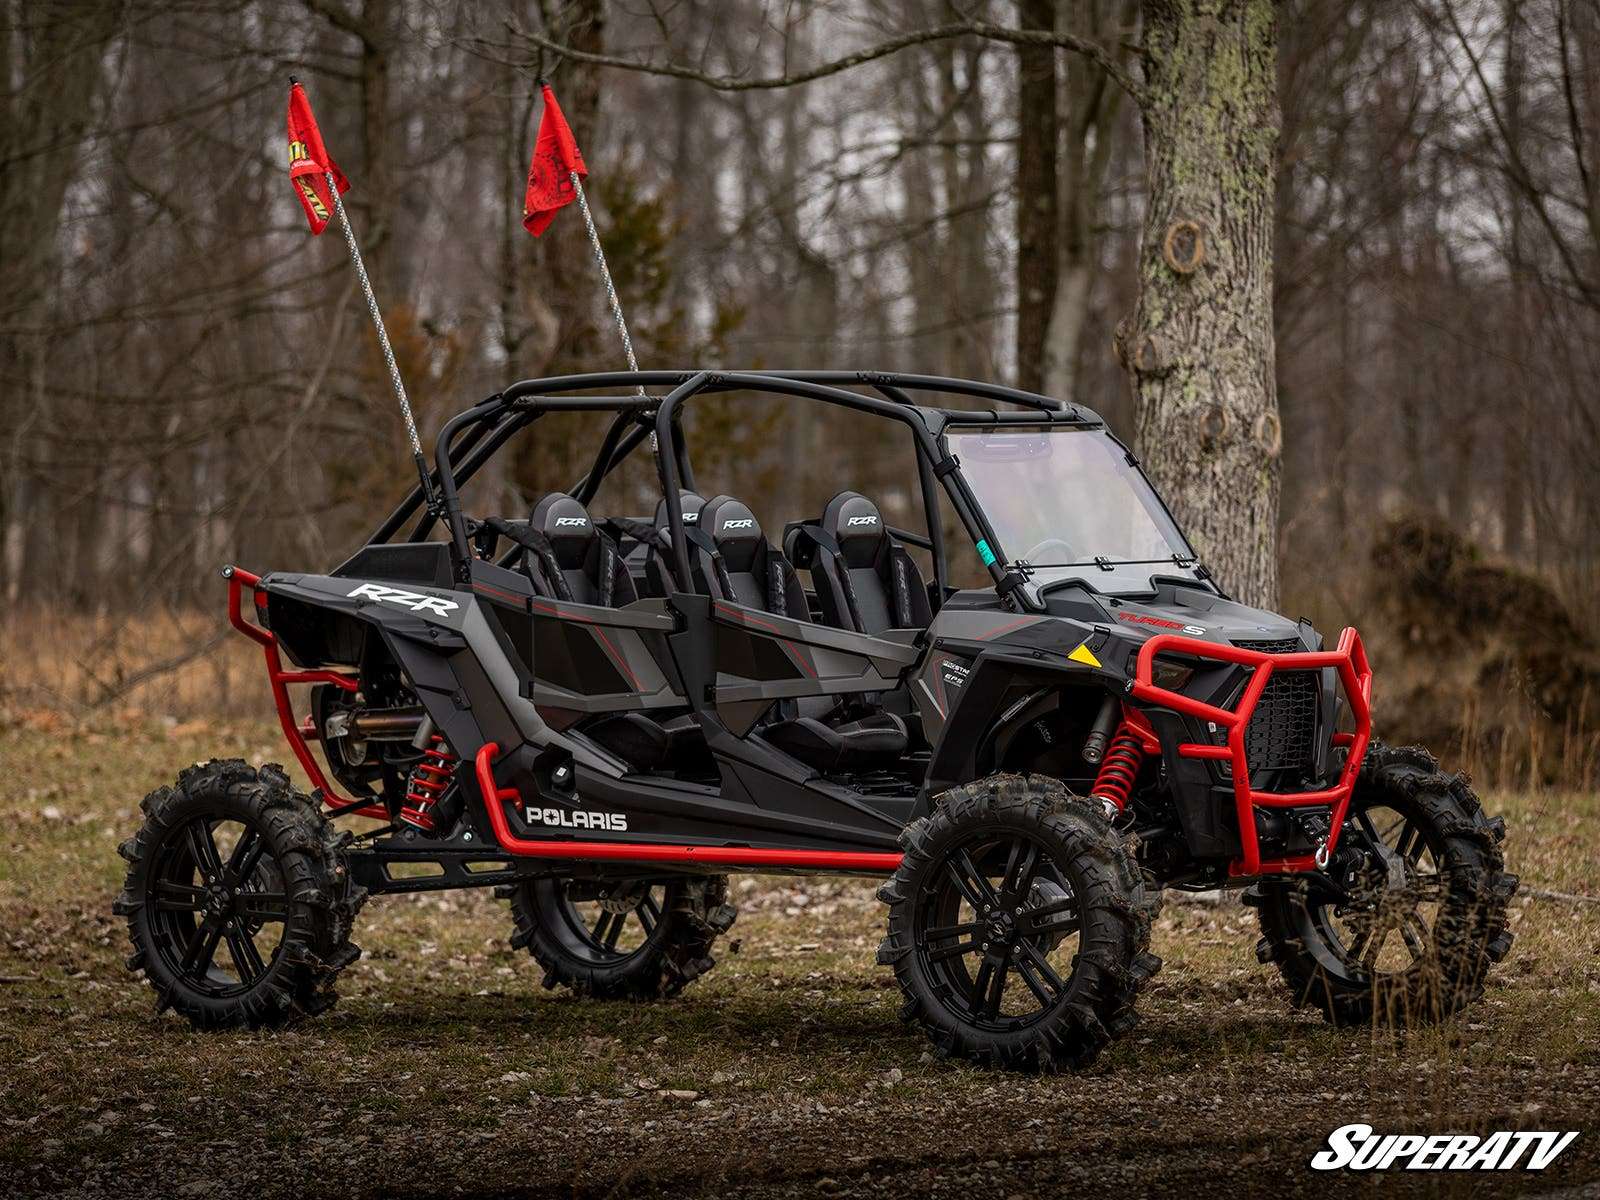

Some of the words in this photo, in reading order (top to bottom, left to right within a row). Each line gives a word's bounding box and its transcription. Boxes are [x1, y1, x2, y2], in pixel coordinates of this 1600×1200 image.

[555, 517, 587, 527] RZR
[682, 512, 699, 521] RZ
[847, 515, 878, 526] RZR
[723, 519, 753, 530] RZR
[346, 583, 459, 618] RZR
[1118, 611, 1185, 630] TURBO
[1182, 624, 1206, 636] S
[944, 673, 964, 684] EPS
[526, 807, 628, 832] POLARIS
